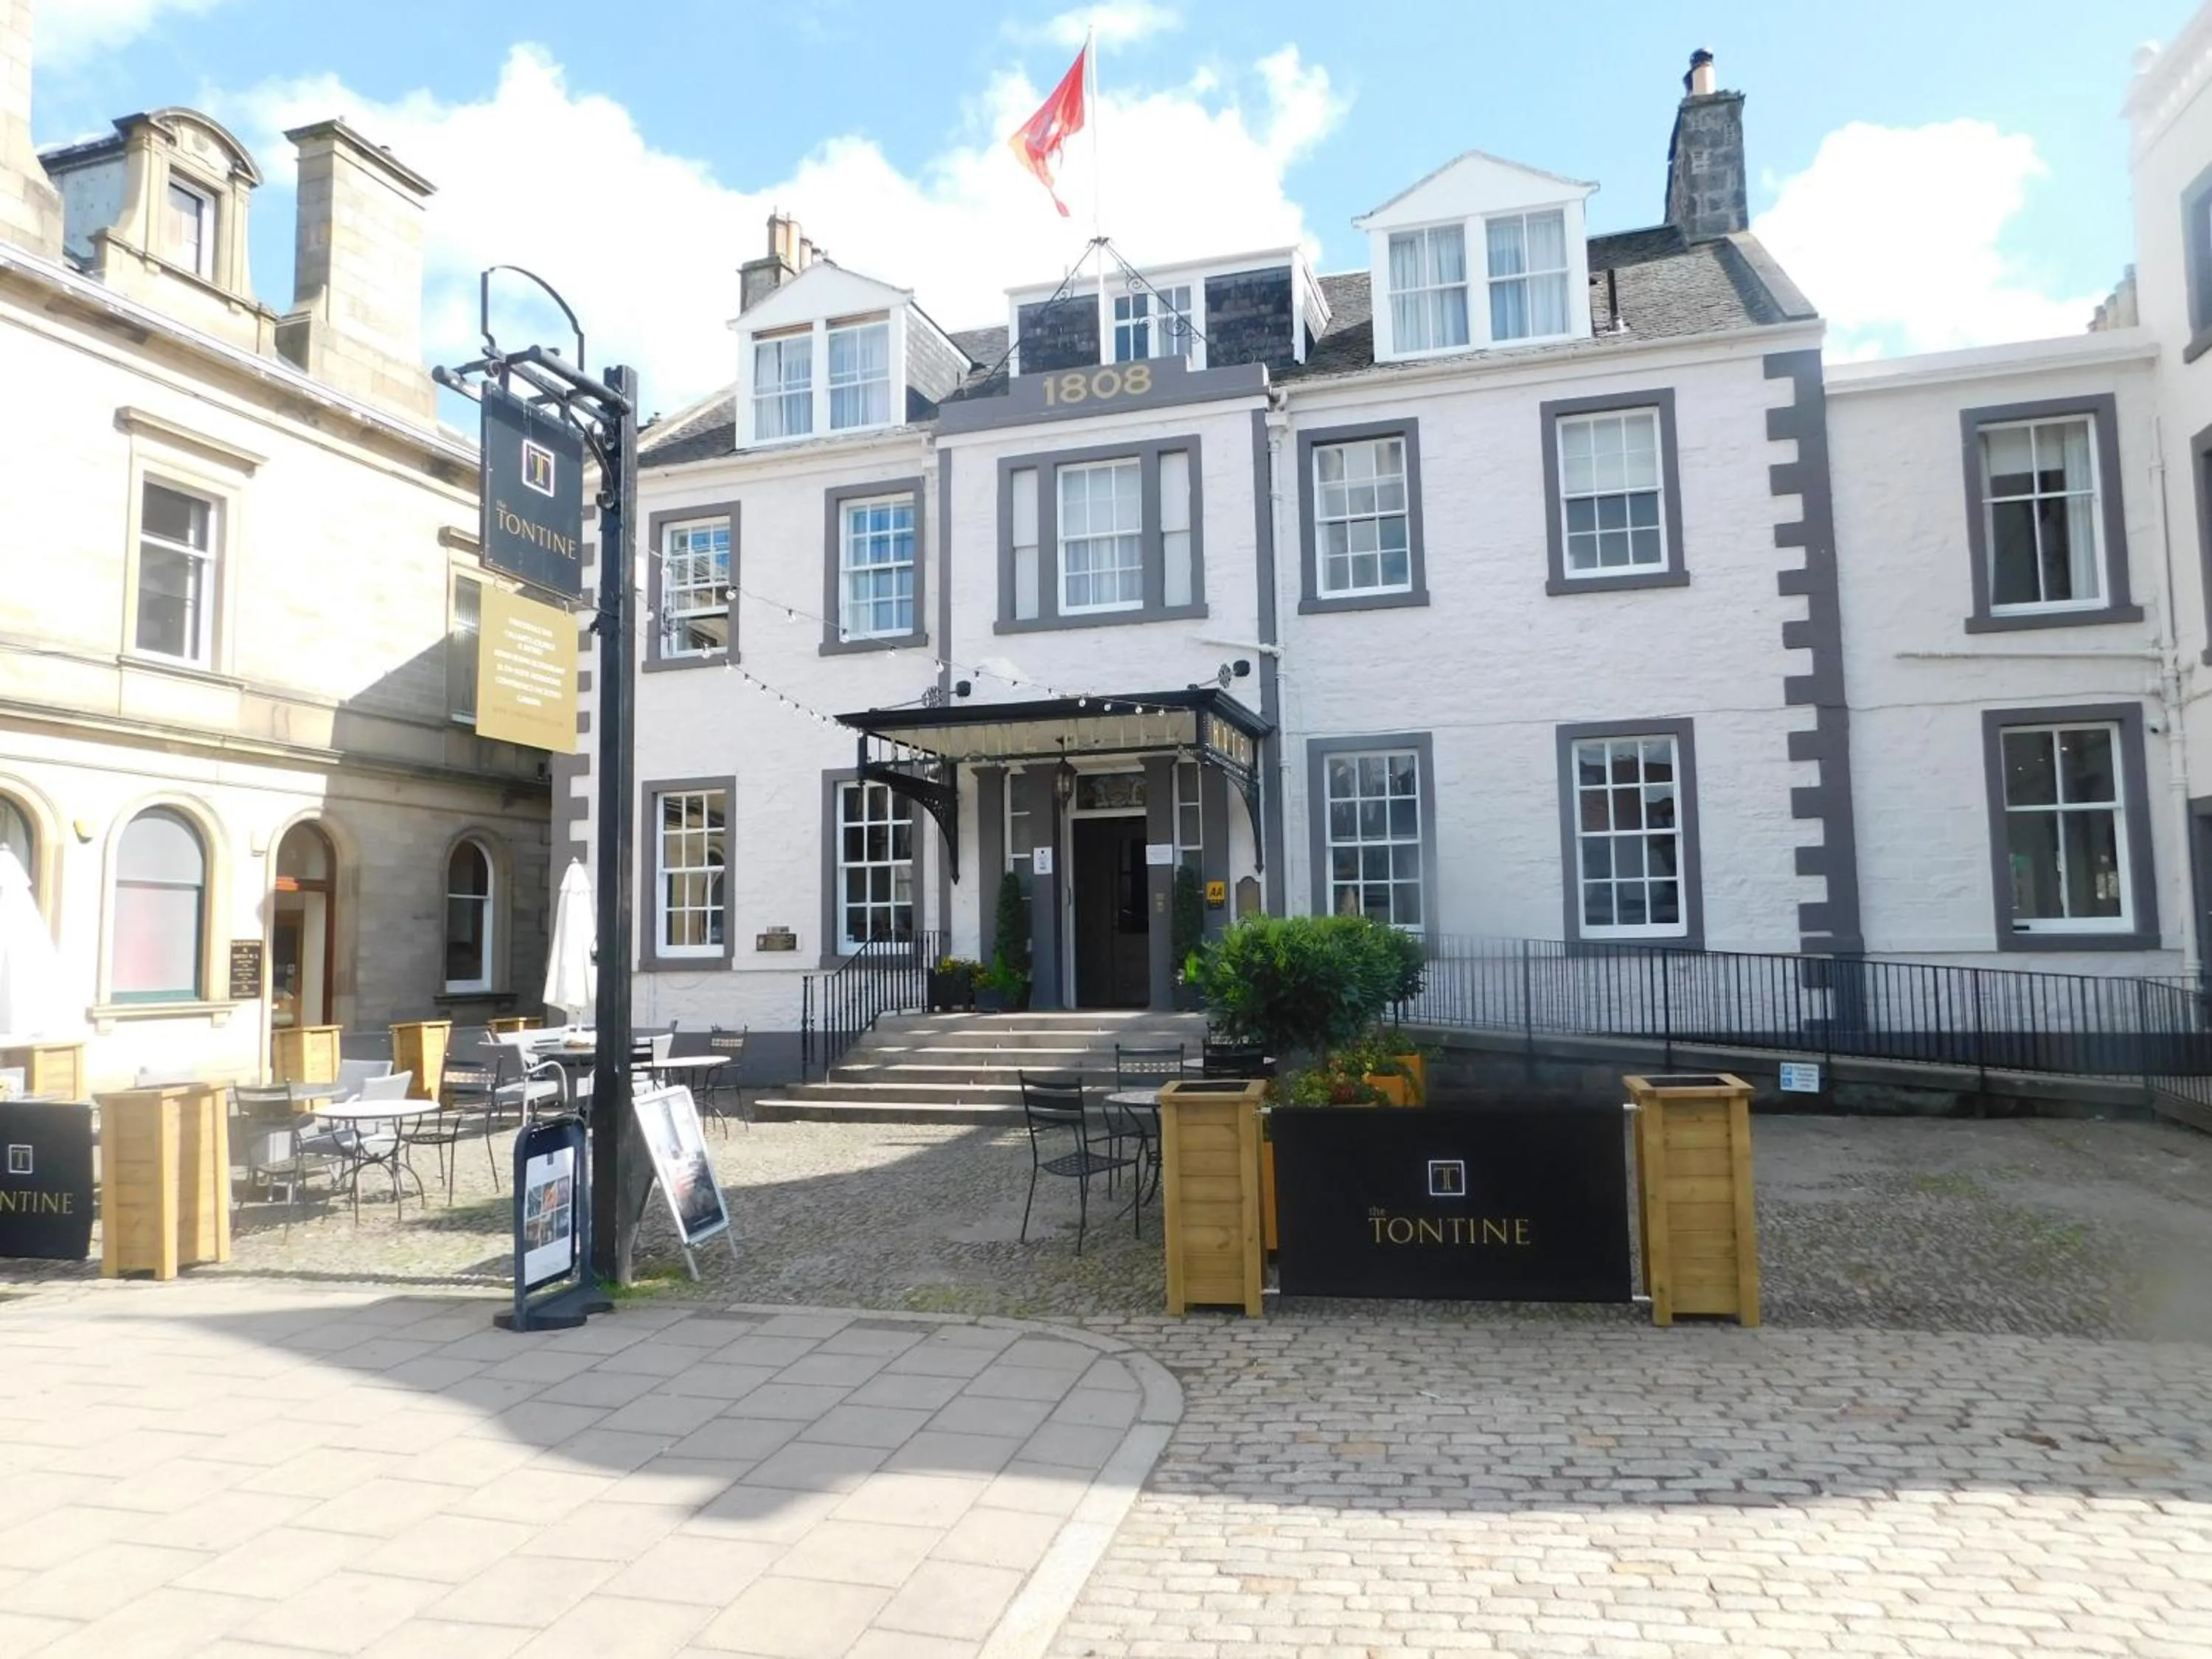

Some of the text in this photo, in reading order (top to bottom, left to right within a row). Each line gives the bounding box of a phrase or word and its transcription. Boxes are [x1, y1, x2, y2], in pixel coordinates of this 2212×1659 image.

[1043, 364, 1152, 406] 1808
[496, 507, 577, 560] TONTINE
[1368, 1206, 1386, 1216] the
[1368, 1217, 1531, 1245] TONTINE
